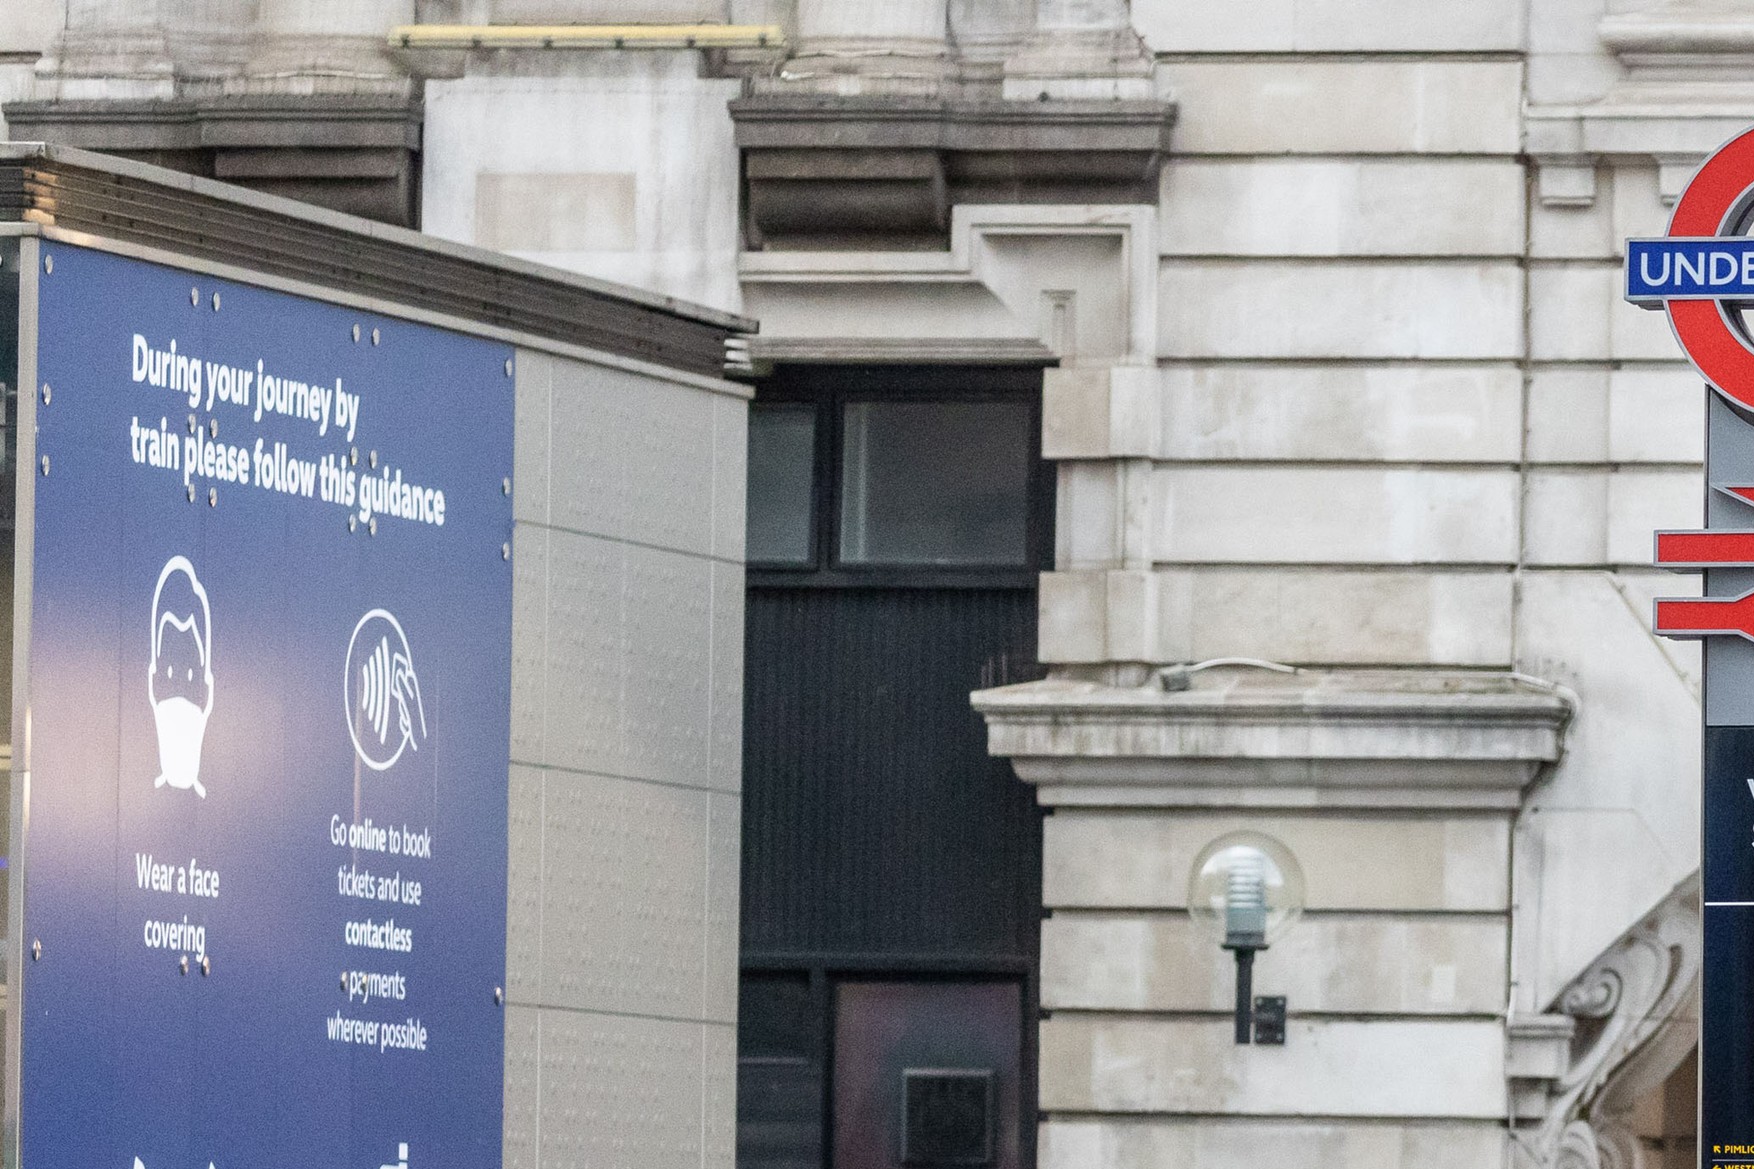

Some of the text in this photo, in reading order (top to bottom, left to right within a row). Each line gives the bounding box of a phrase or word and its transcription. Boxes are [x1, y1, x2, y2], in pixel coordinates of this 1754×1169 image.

[132, 334, 359, 442] During your journey by
[131, 416, 445, 526] train please follow this guidance
[330, 814, 431, 858] Go online to book
[136, 853, 220, 898] Wear a face
[338, 864, 422, 905] tickets and use
[144, 915, 205, 962] covering
[345, 918, 412, 952] contactless
[349, 970, 406, 1004] payments
[327, 1010, 427, 1052] wherever possible
